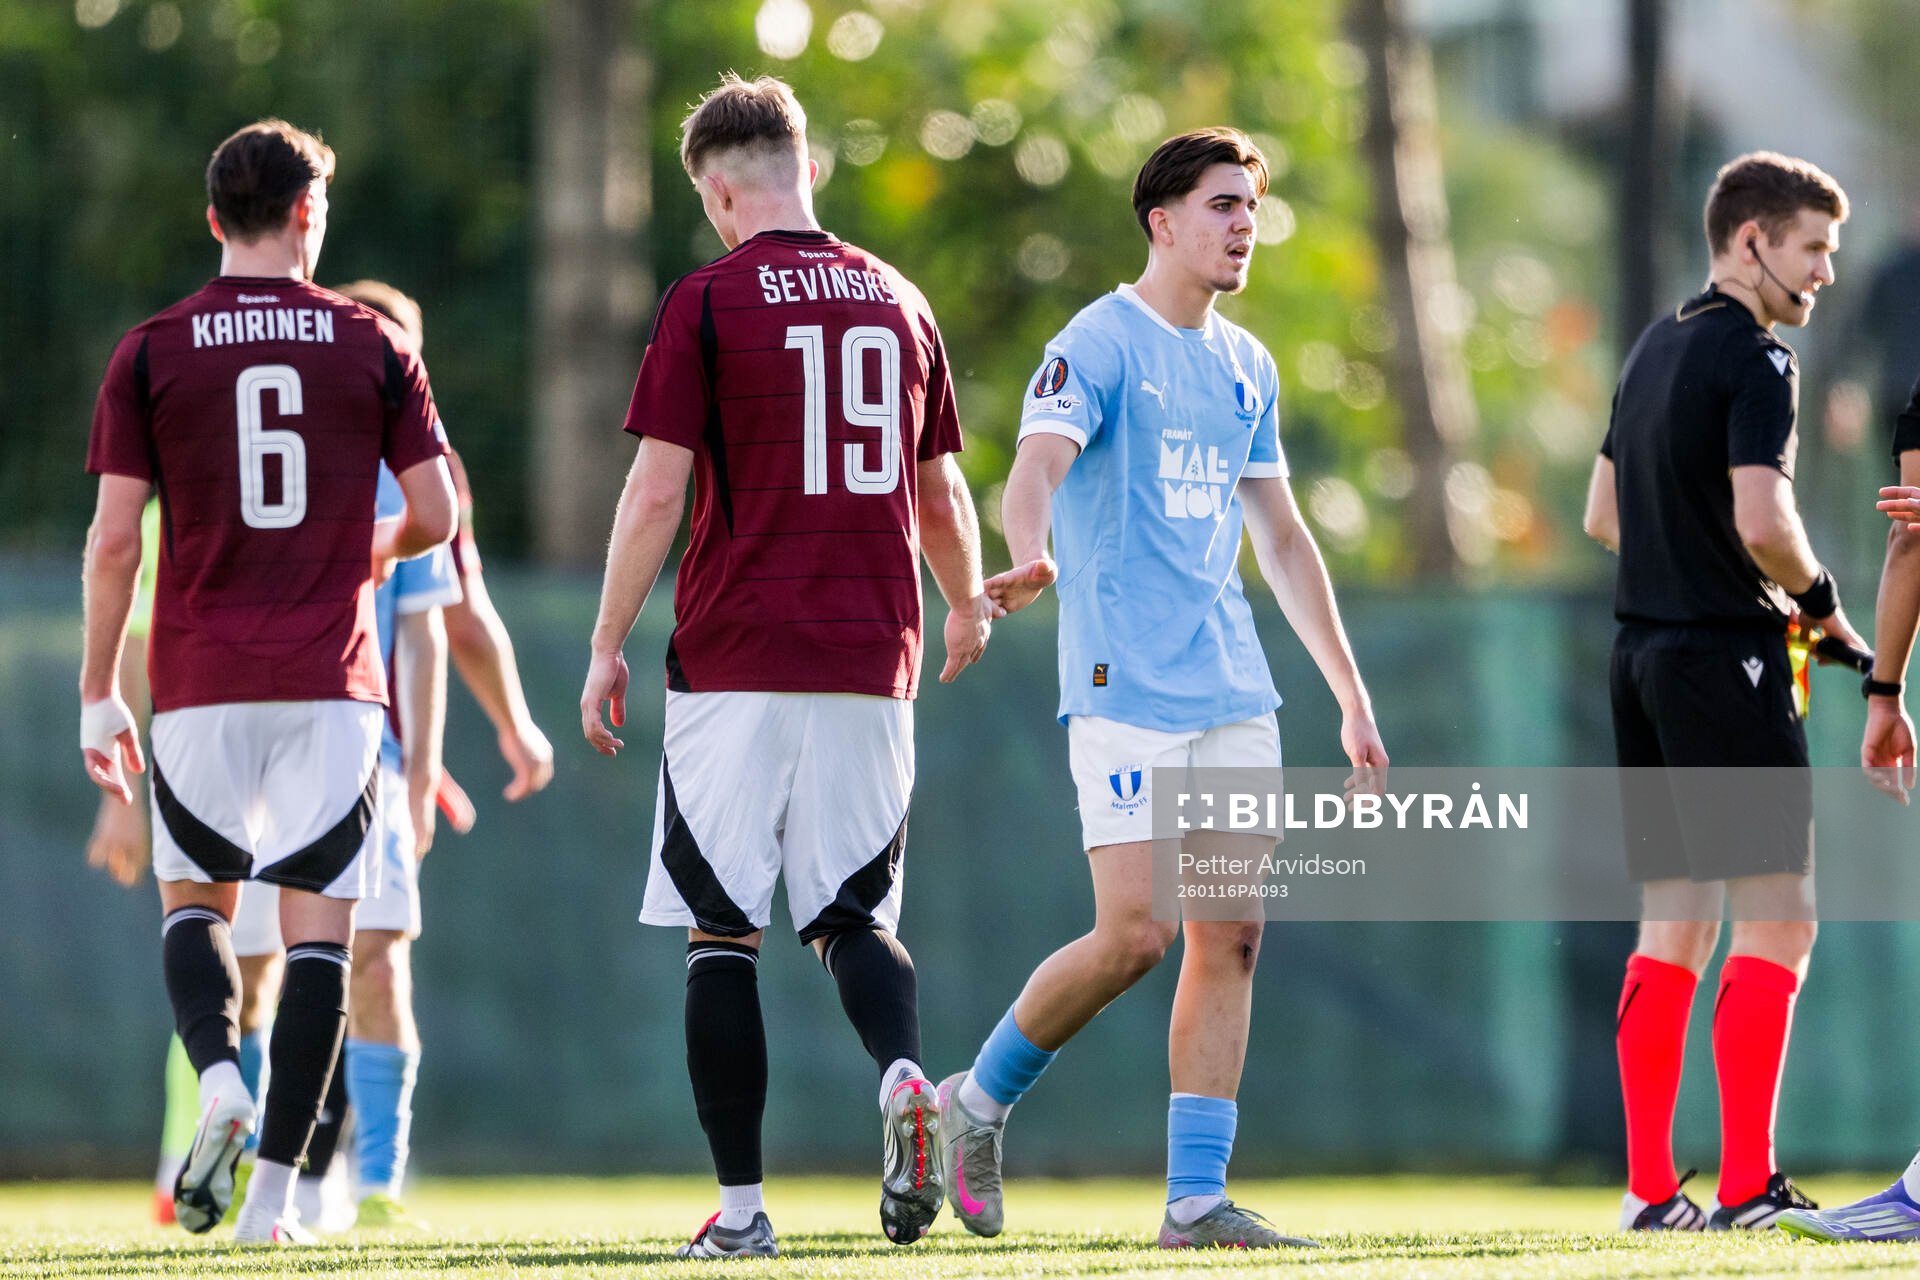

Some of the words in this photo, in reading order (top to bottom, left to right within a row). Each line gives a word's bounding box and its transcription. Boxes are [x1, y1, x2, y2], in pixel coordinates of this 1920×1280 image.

[192, 309, 334, 348] KAIRINEN
[784, 325, 900, 495] 19
[236, 364, 307, 529] 6
